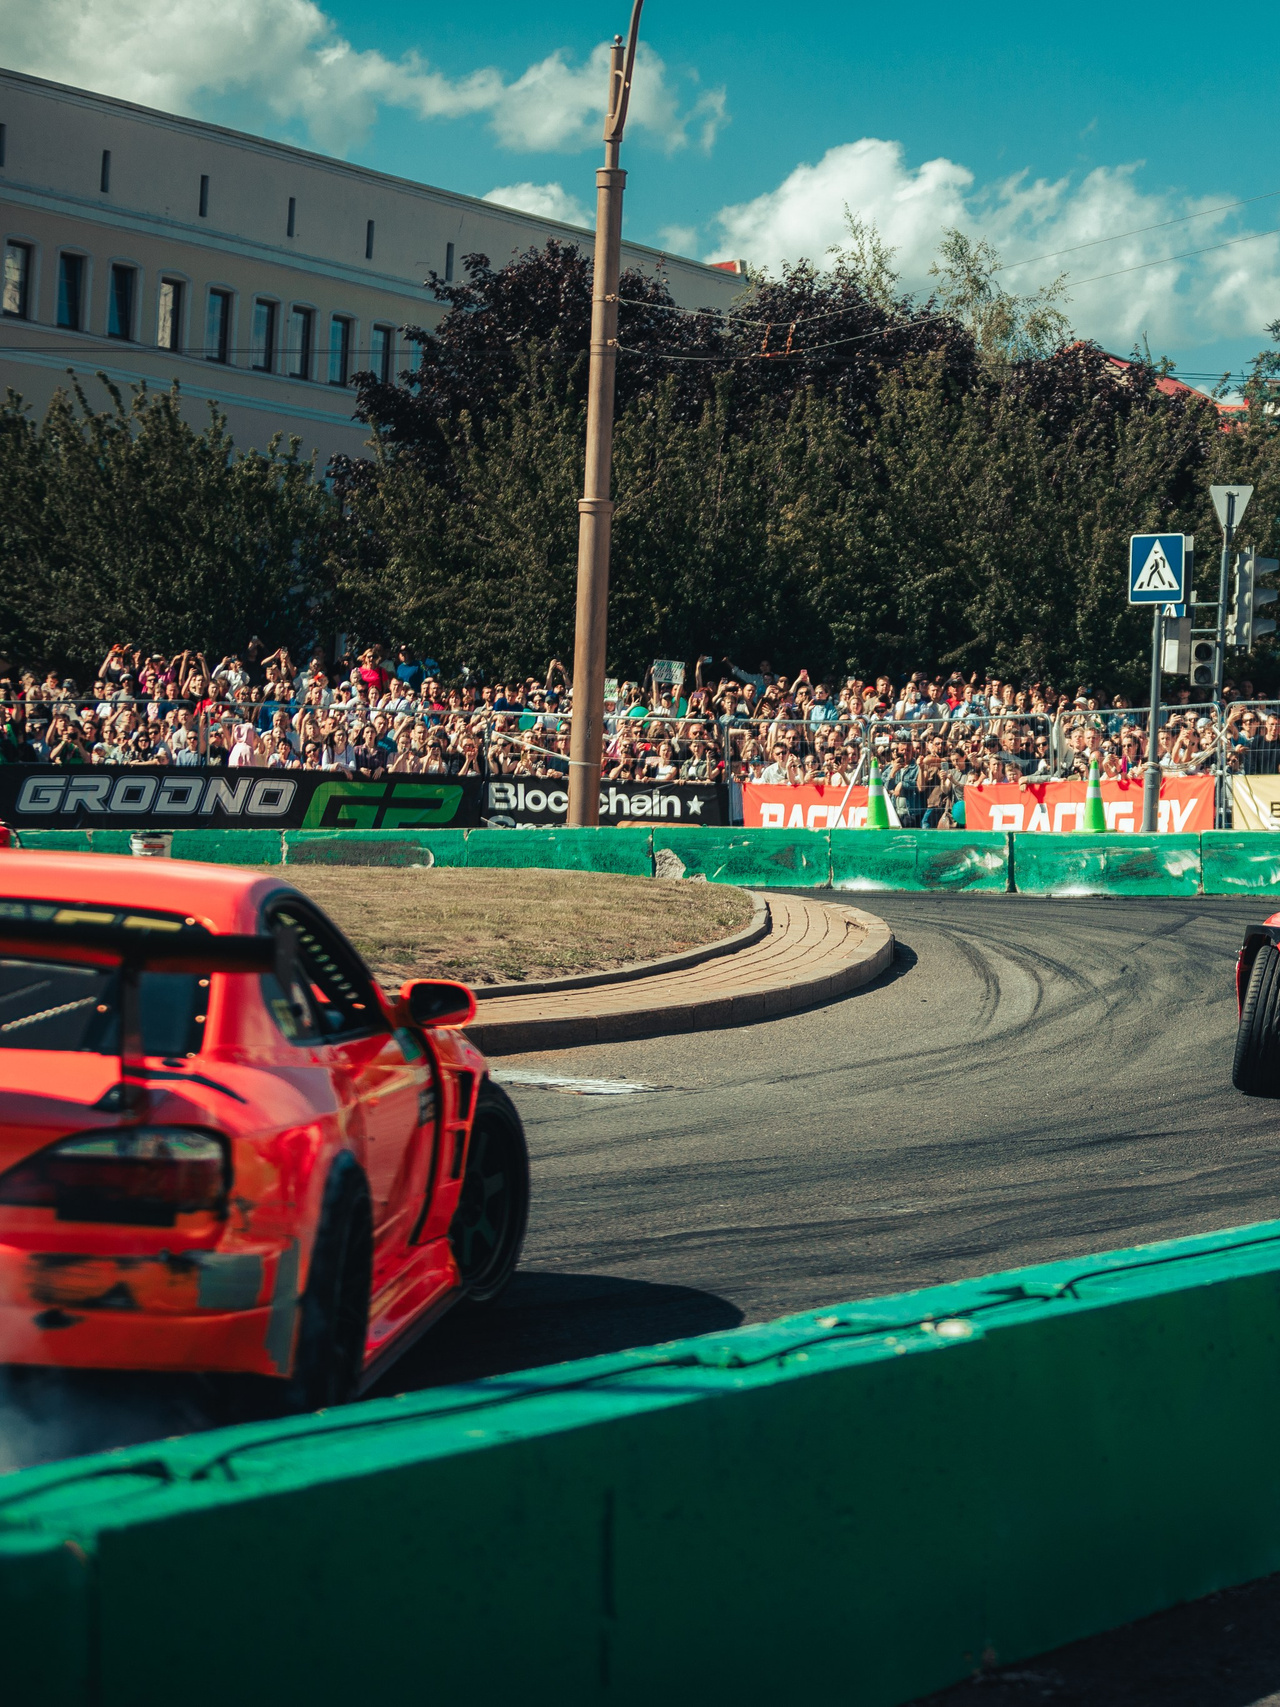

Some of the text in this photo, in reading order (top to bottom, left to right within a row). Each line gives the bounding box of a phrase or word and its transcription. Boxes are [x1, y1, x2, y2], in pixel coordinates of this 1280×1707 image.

[17, 775, 464, 829] GRODNO GP
[488, 782, 682, 818] Blocchain
